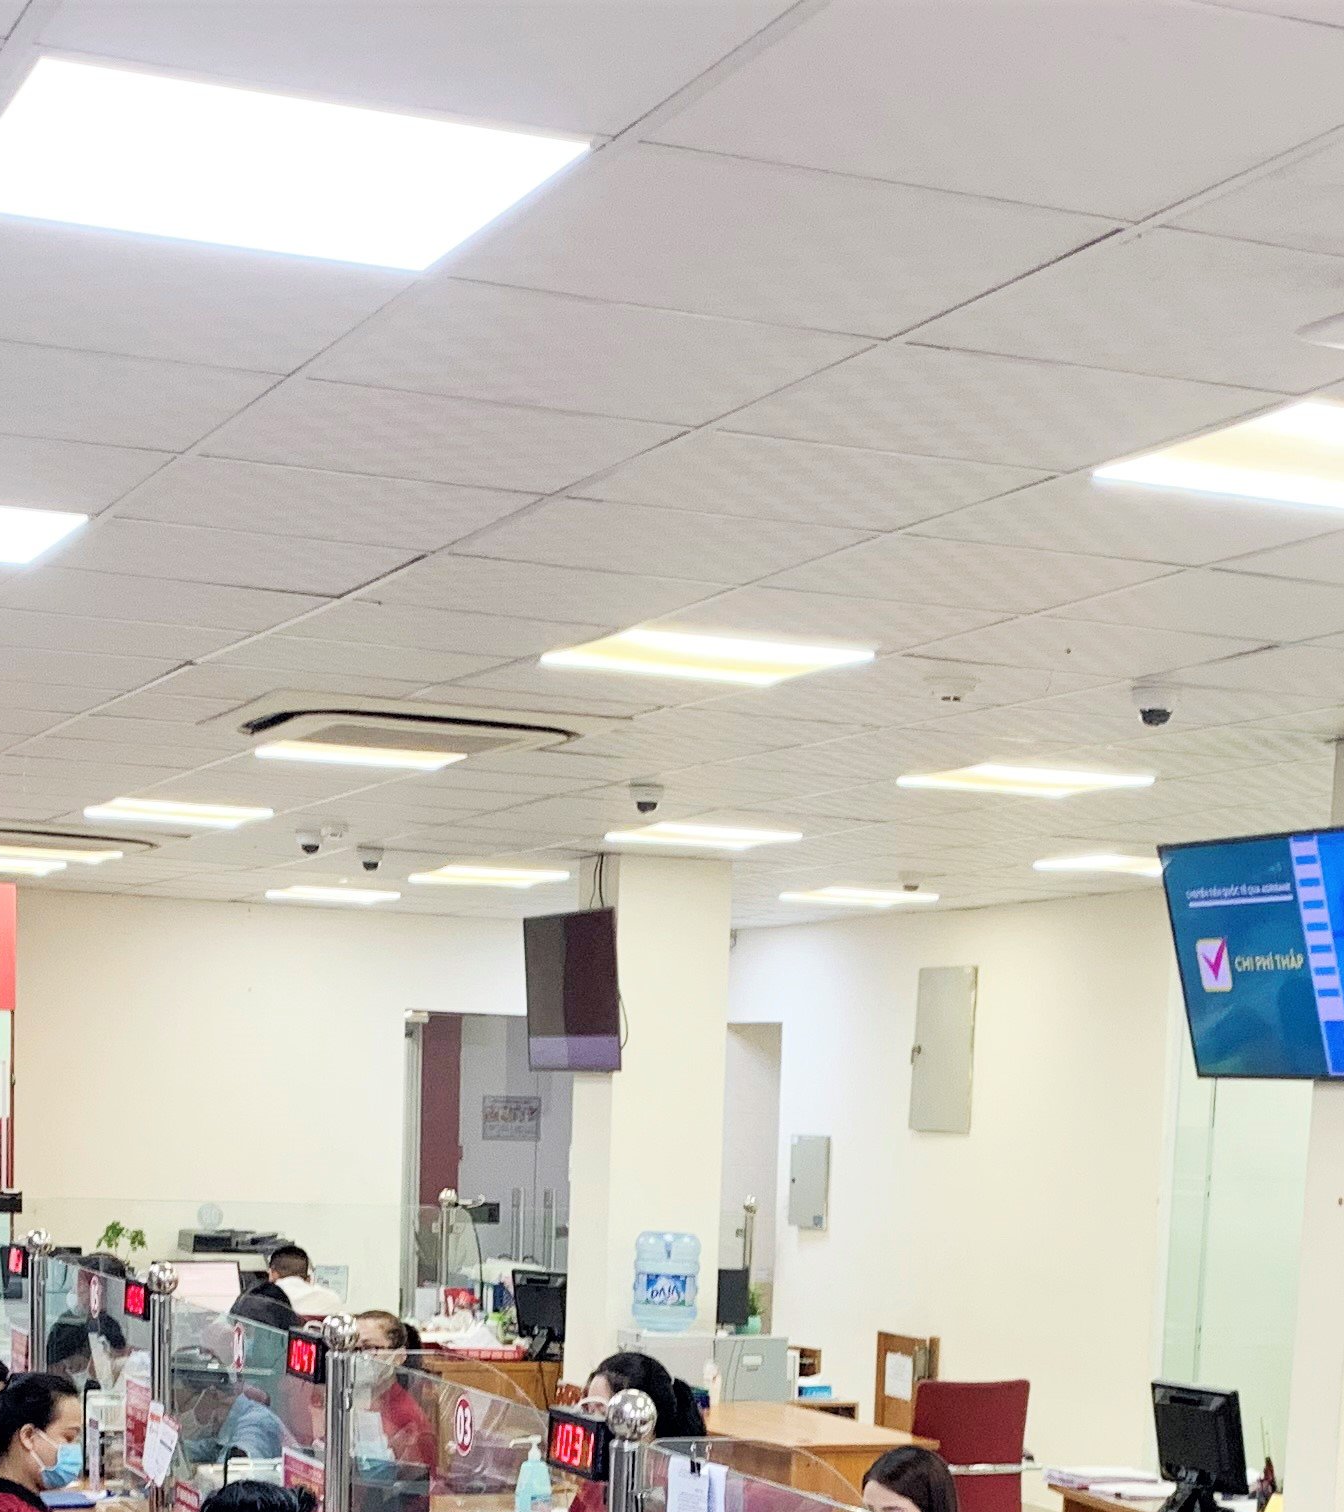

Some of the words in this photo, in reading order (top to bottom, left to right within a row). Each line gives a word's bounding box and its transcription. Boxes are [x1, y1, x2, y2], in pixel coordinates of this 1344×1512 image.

[1235, 955, 1255, 972] CHI
[457, 1406, 471, 1446] 03
[555, 1424, 595, 1468] 1031
